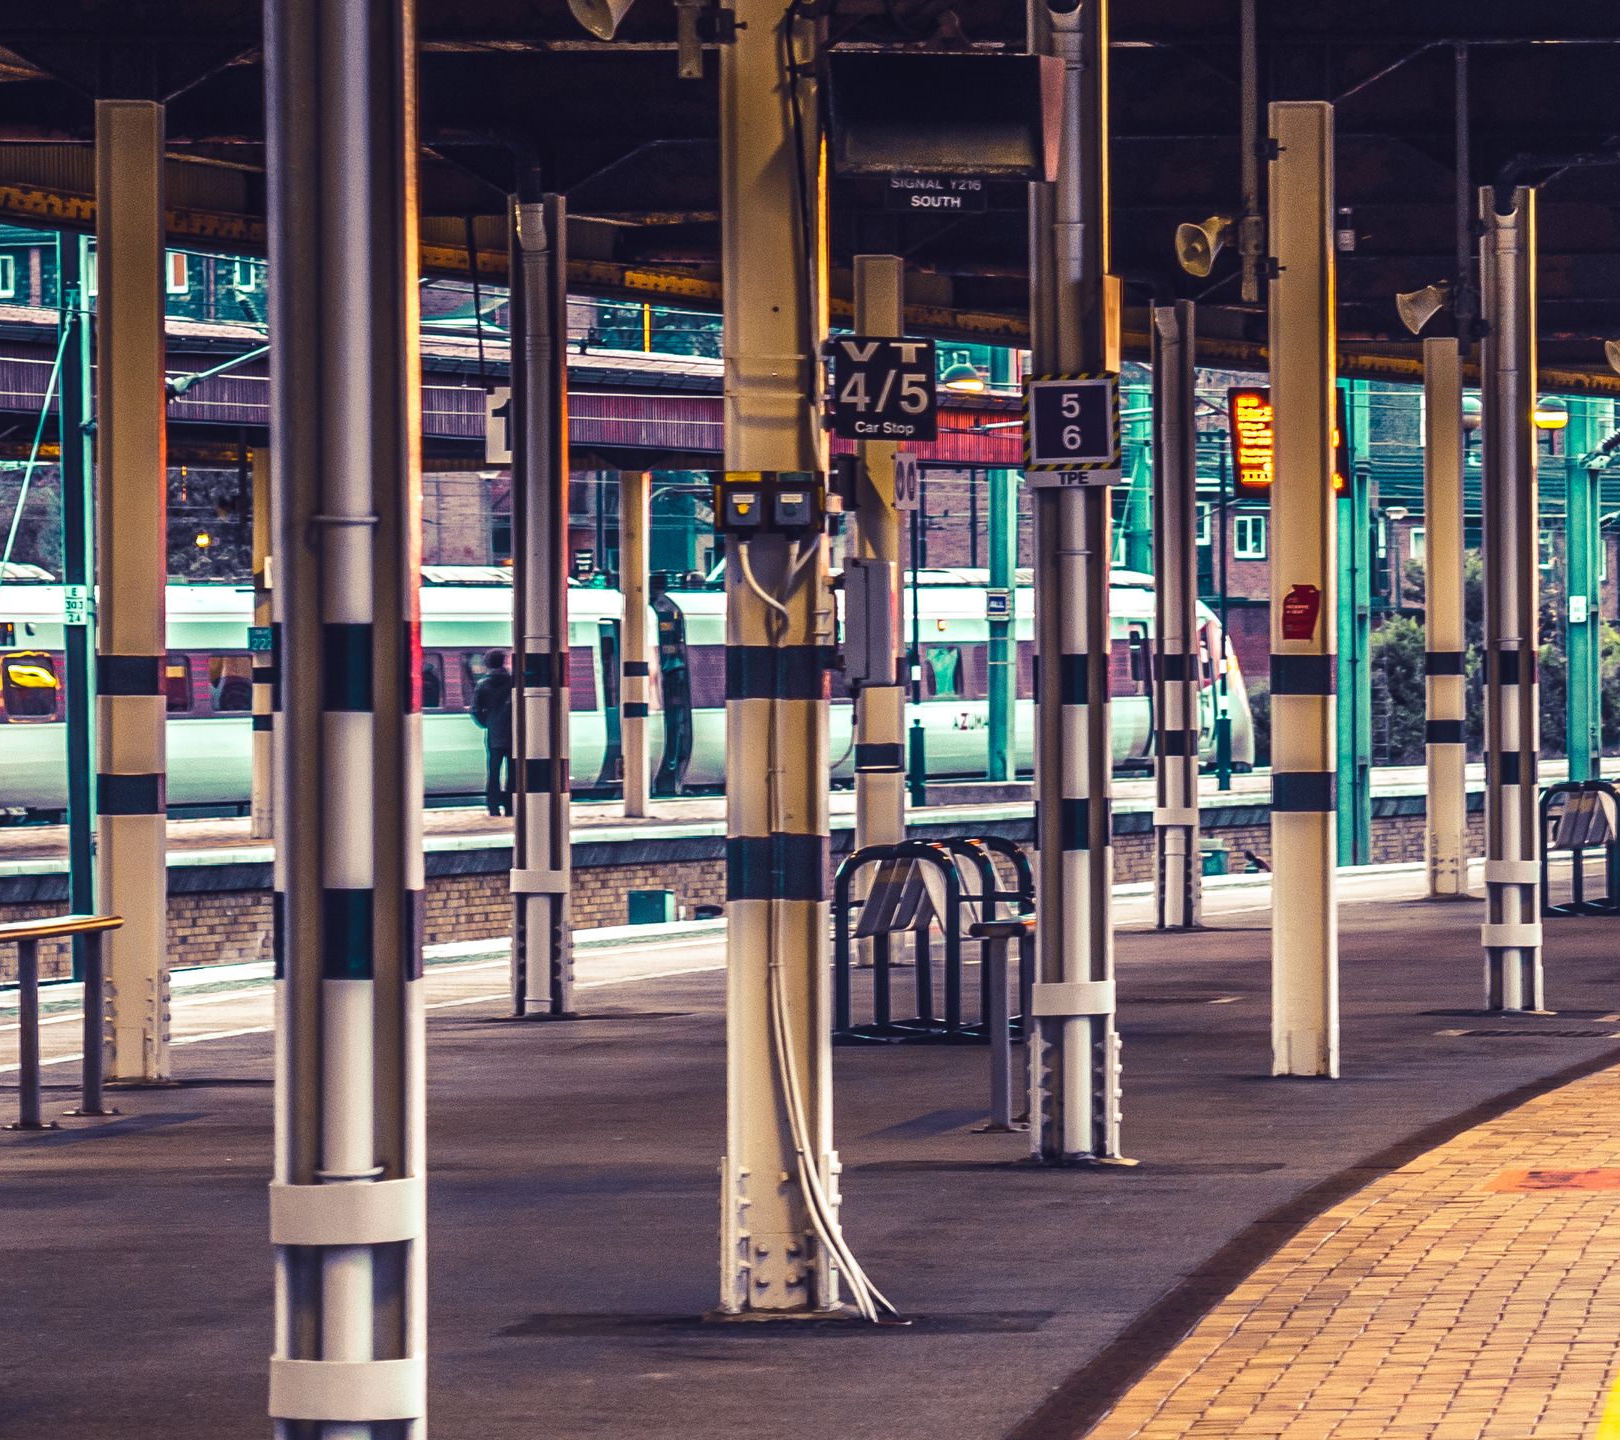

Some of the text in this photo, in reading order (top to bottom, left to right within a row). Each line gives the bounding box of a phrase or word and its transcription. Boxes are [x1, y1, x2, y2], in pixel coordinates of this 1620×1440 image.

[890, 177, 982, 191] SIGNAL Y216
[911, 195, 962, 208] SOUTH
[839, 369, 929, 414] 4/5
[1061, 393, 1081, 418] 5
[855, 421, 915, 436] Car Stop
[1062, 425, 1082, 450] 6
[1059, 471, 1089, 485] TPE
[69, 614, 80, 623] 24
